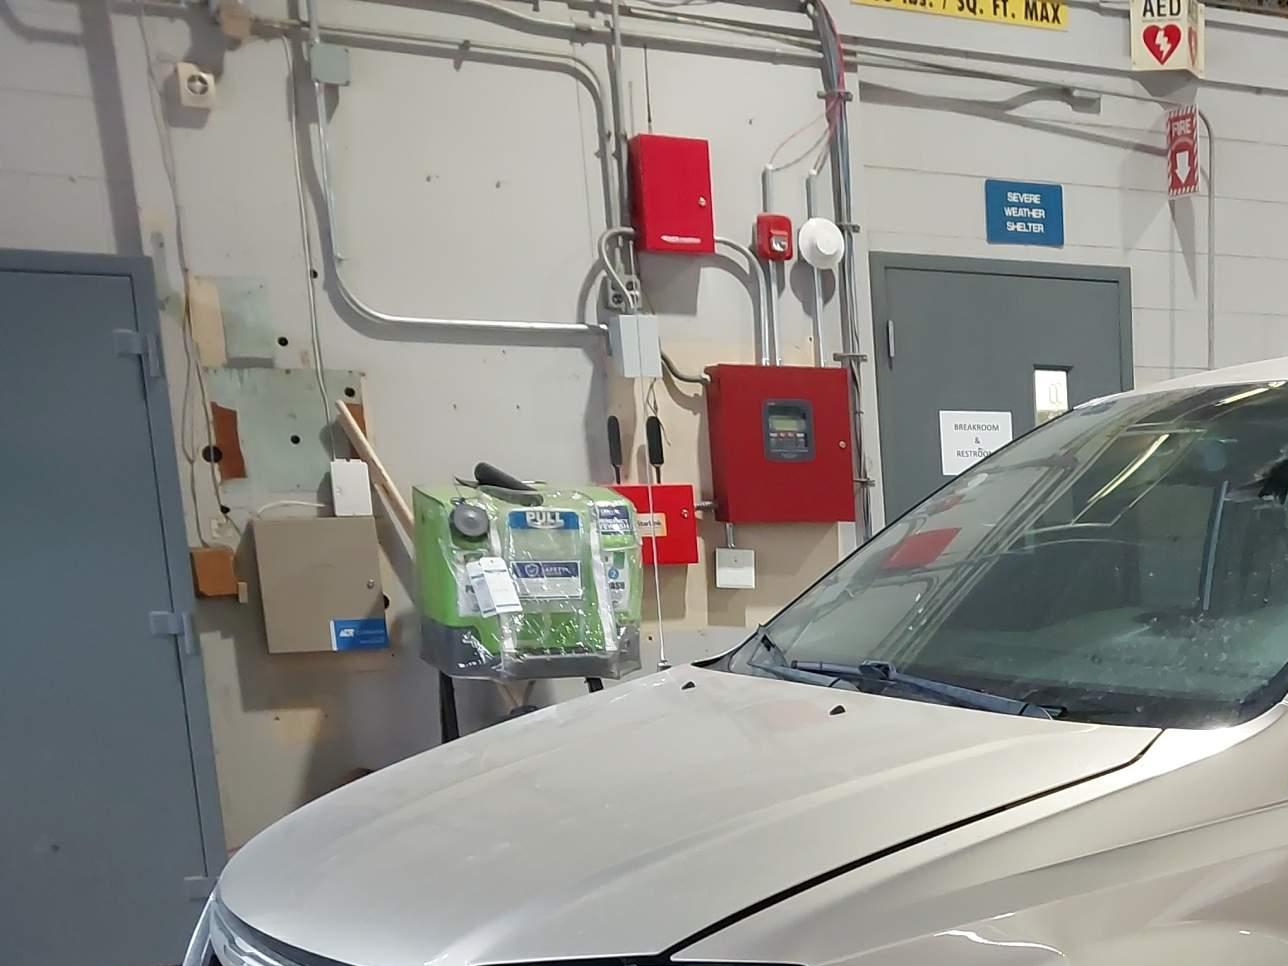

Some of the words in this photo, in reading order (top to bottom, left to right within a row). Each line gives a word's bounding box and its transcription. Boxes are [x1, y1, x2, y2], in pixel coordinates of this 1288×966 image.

[1023, 0, 1061, 24] MAX
[1142, 0, 1181, 17] AED
[1171, 118, 1193, 138] FIRE
[1007, 191, 1041, 204] SEVERE
[1003, 206, 1046, 219] WEATHER
[1006, 221, 1045, 233] SHELTER
[954, 423, 1000, 431] BREAKROOM
[525, 511, 564, 524] PULL
